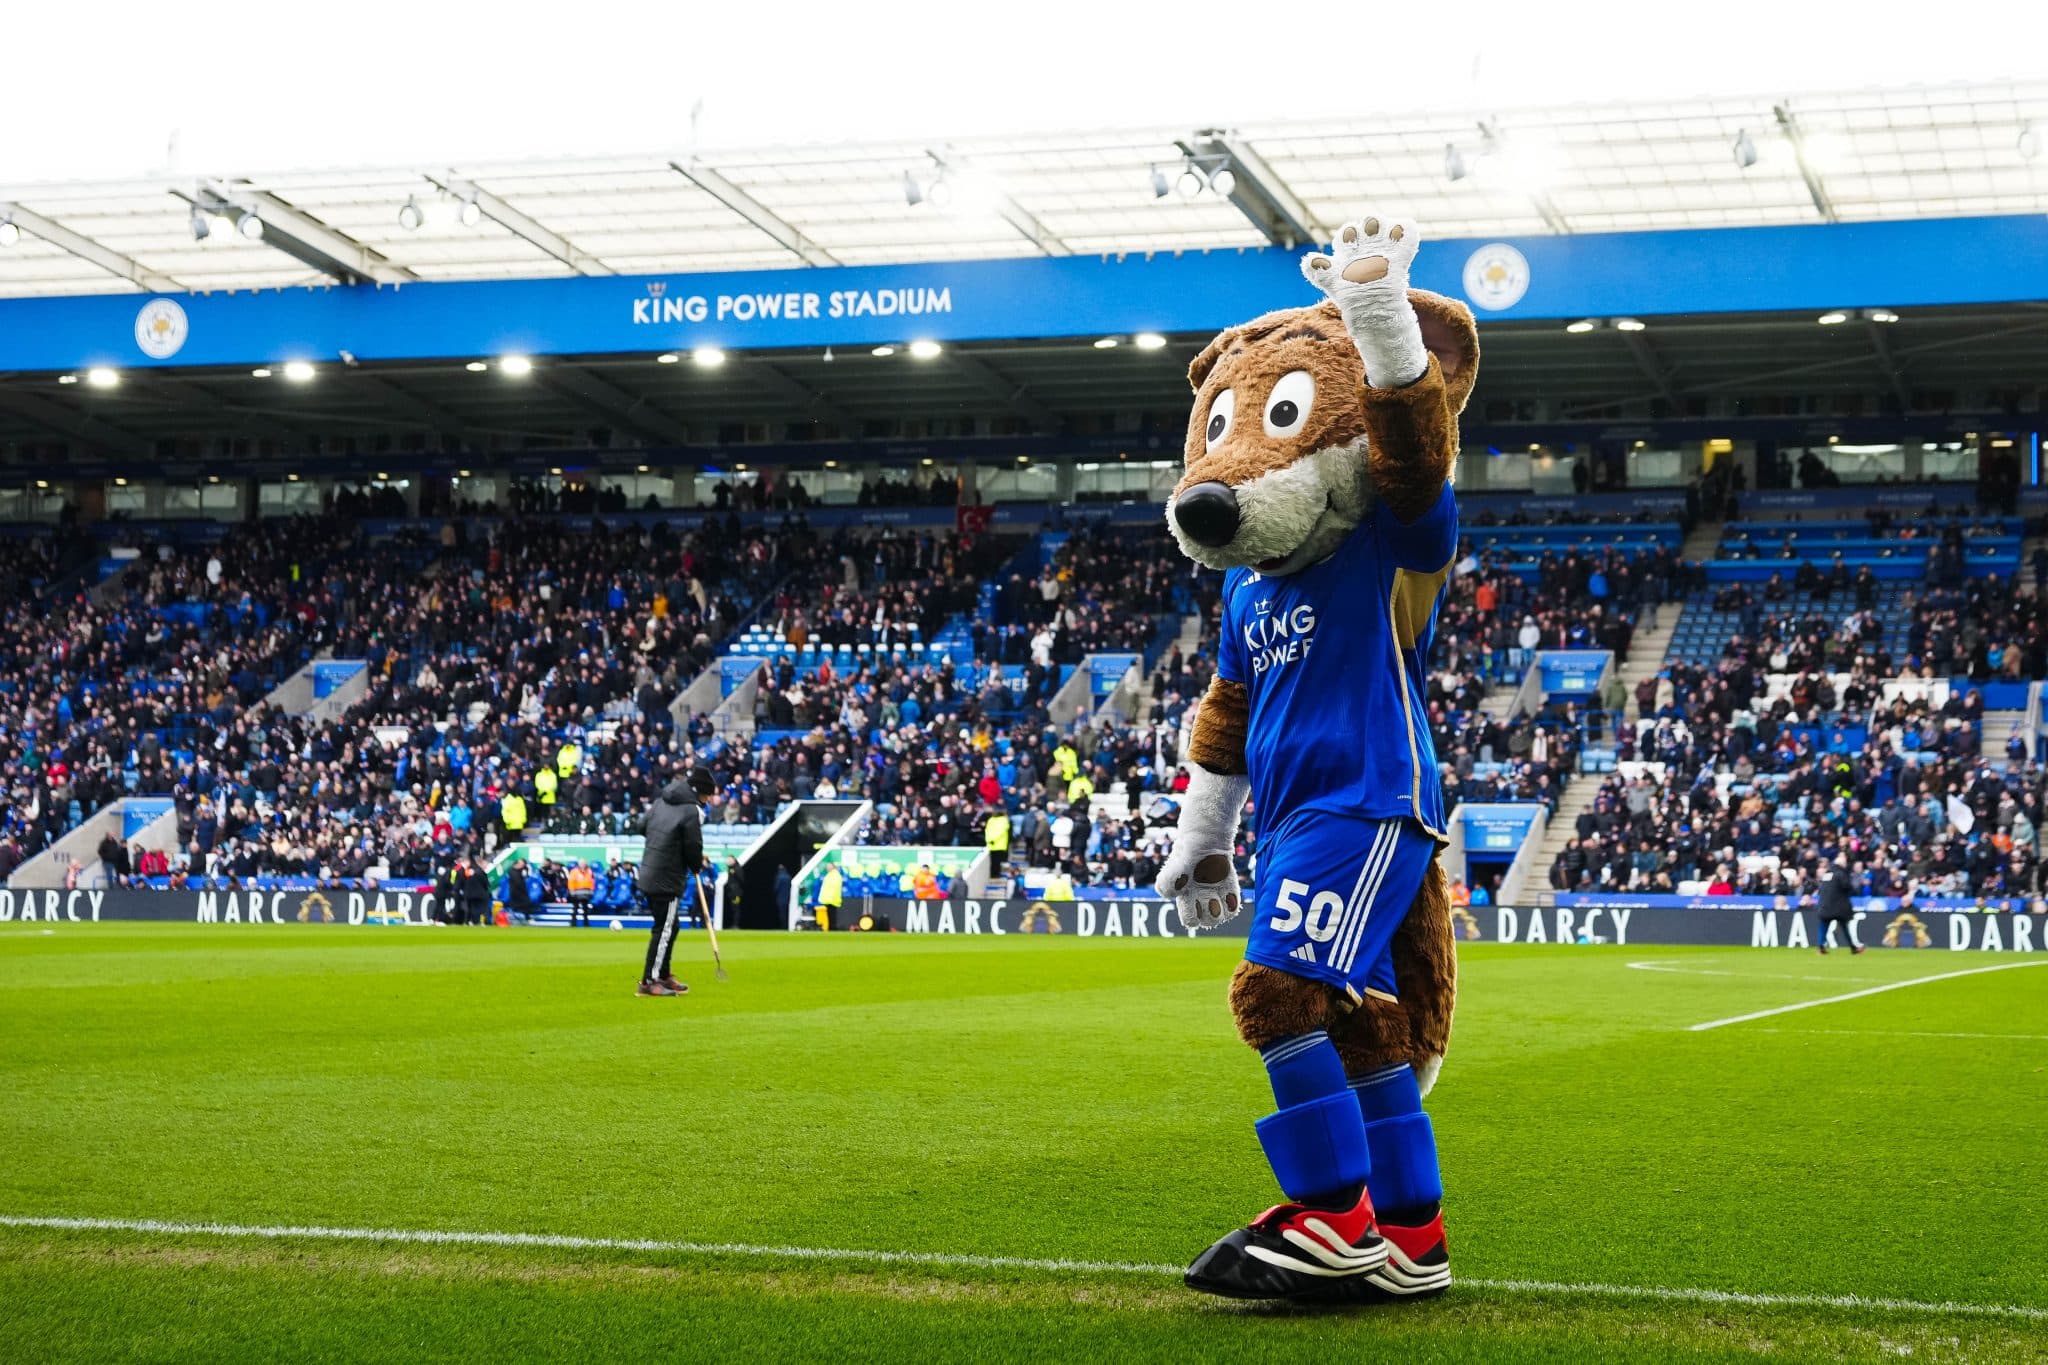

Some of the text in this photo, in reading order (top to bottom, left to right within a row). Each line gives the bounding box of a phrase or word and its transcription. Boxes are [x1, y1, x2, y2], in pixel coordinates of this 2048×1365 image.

[633, 287, 952, 324] KING POWER STADIUM
[1244, 605, 1315, 651] KING
[0, 889, 104, 921] DARCY
[197, 891, 286, 923] MARC
[906, 900, 1197, 938] MARC DARC
[1270, 878, 1344, 942] 50
[1498, 908, 1631, 945] DARCY
[1950, 913, 2048, 952] DAR
